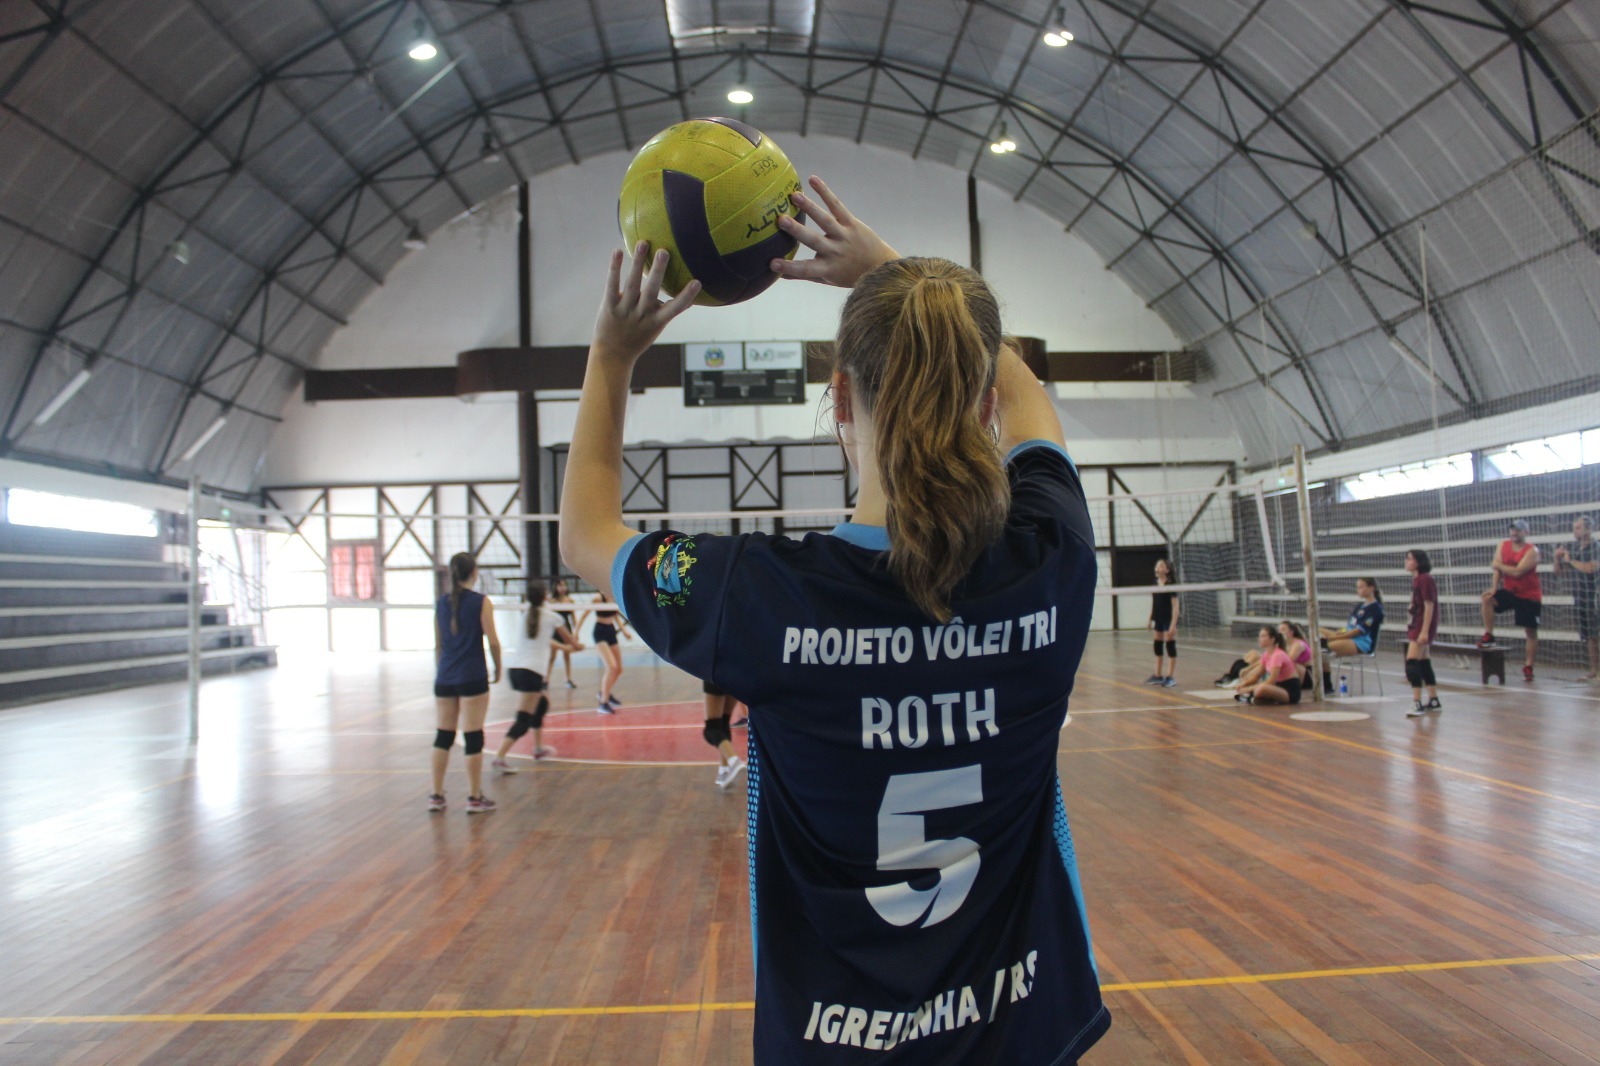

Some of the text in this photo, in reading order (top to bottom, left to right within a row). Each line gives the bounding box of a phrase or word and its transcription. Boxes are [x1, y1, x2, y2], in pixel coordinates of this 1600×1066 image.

[782, 605, 1058, 666] PROJETO VÔLEI TRI
[861, 687, 1000, 750] ROTH
[864, 763, 984, 929] 5
[803, 985, 981, 1051] IGREJINHA
